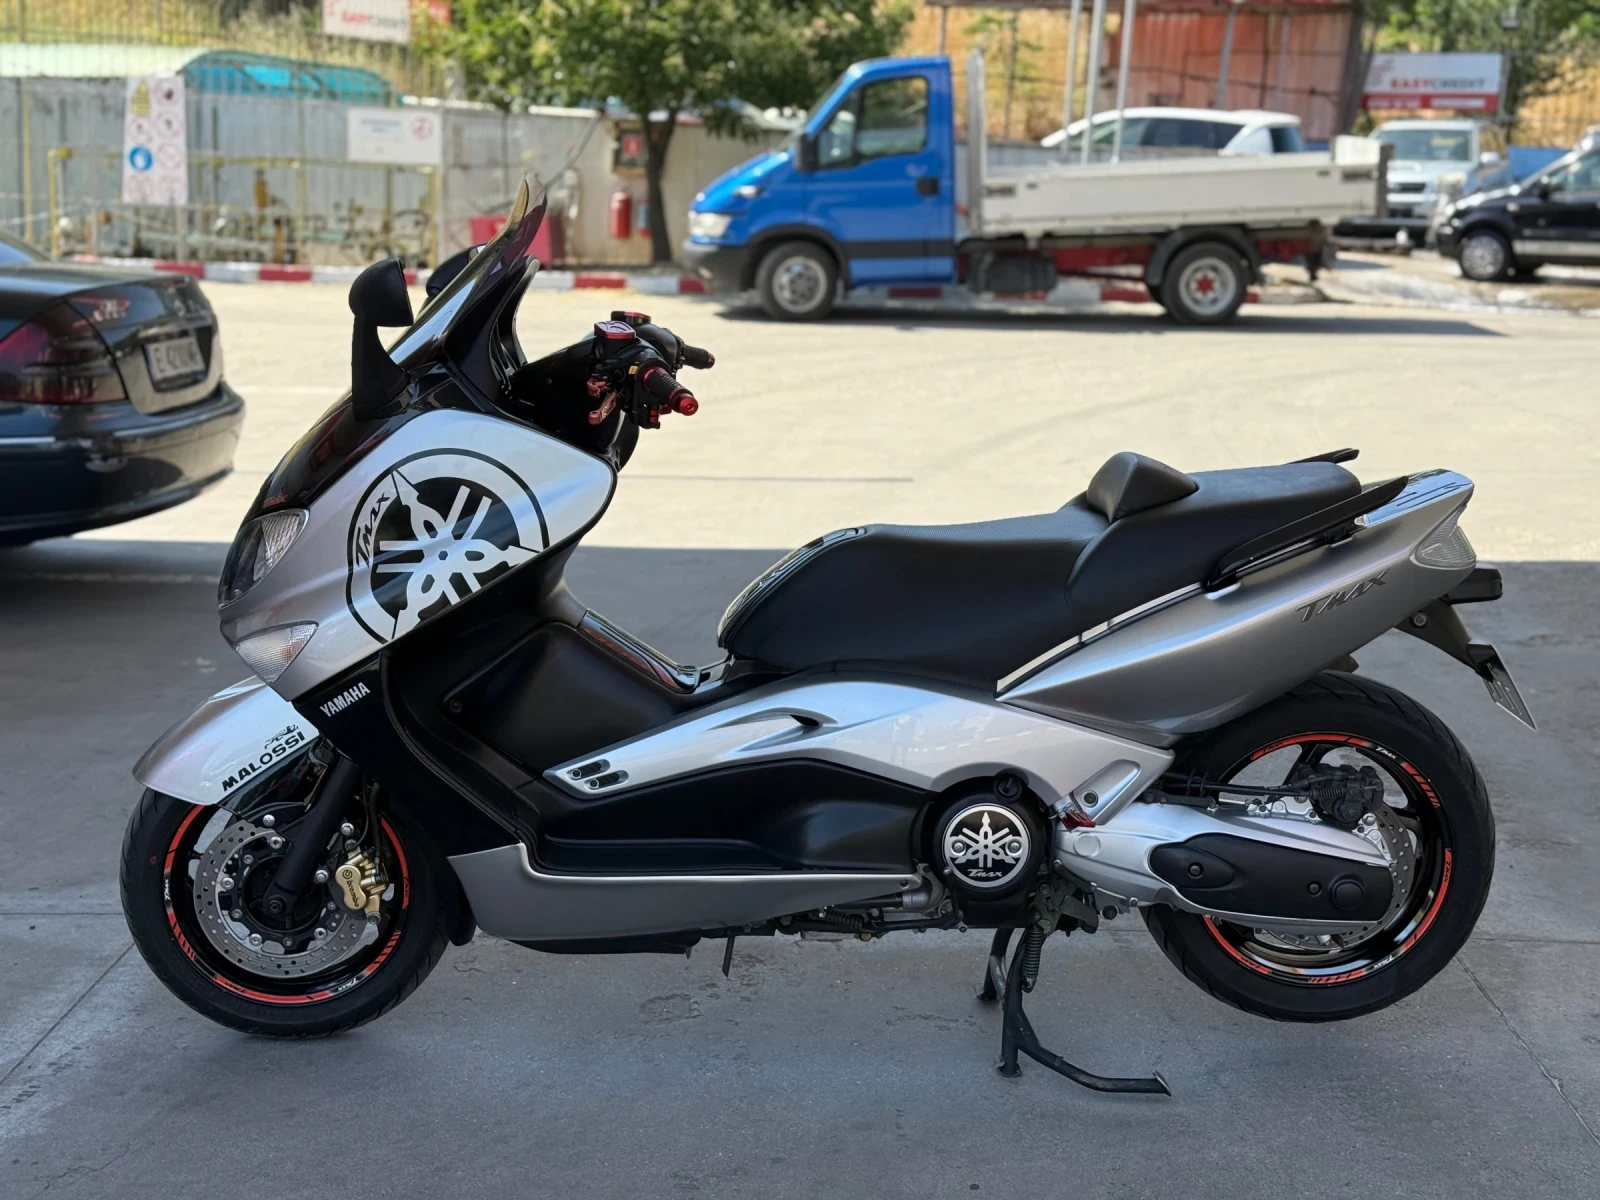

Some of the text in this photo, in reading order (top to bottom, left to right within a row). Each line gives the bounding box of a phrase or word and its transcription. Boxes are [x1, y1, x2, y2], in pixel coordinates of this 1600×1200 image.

[319, 681, 371, 717] YAMAHA
[221, 730, 306, 792] MALOSSI
[346, 879, 360, 908] brembo
